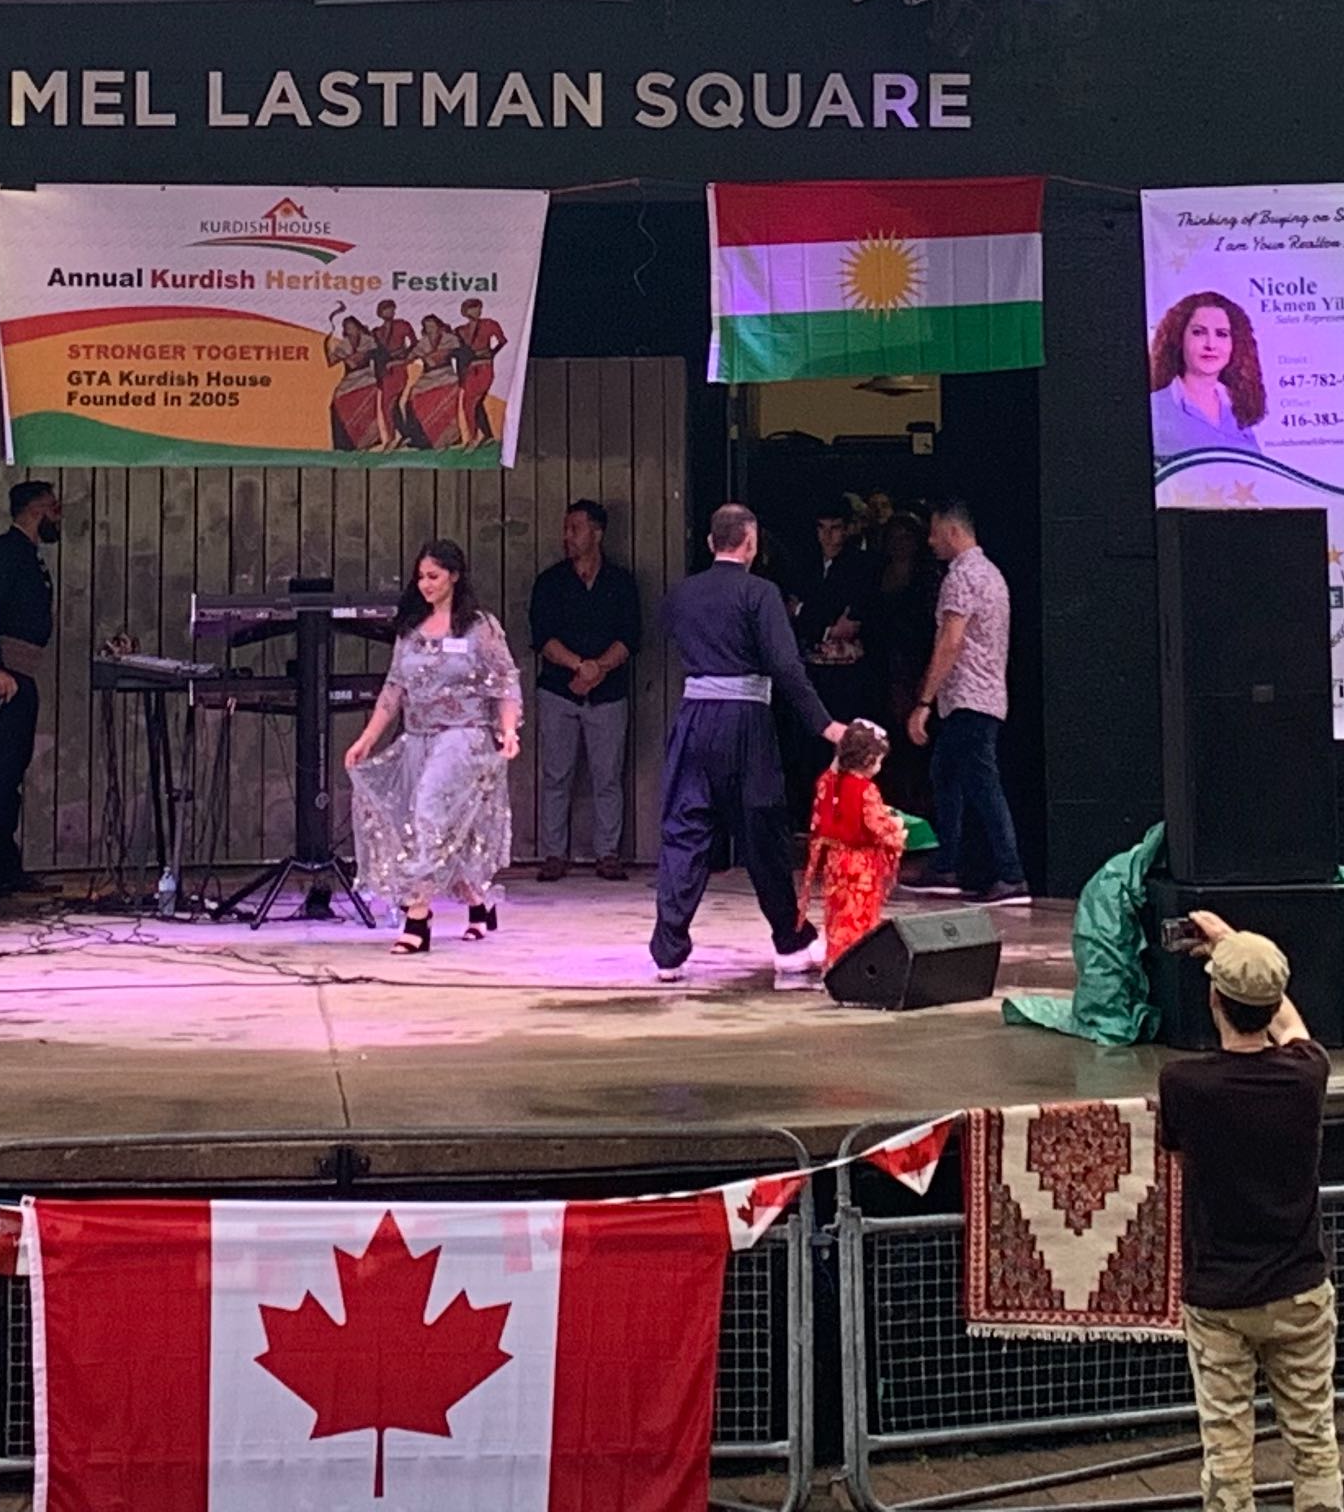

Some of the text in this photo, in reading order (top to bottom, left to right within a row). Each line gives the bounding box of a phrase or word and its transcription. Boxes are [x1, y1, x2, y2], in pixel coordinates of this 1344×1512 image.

[10, 69, 972, 130] MEL LASTMAN SQUARE
[199, 220, 332, 235] KURDISH HOUSE
[1177, 212, 1238, 229] Thinking
[1241, 213, 1256, 228] of
[1259, 210, 1309, 228] Buying
[1312, 214, 1330, 224] or
[1214, 237, 1225, 252] I
[1226, 241, 1249, 252] am
[1254, 236, 1285, 252] Your
[47, 268, 499, 295] Annual Kurdish Heritage Festival
[1248, 276, 1318, 297] Nicole
[1260, 298, 1317, 313] Ekmen
[1274, 314, 1301, 325] Sales
[66, 343, 310, 362] STRONGER TOGETHER
[66, 369, 273, 388] GTA Kurdish House
[66, 390, 156, 408] Founded
[188, 392, 241, 408] 2005
